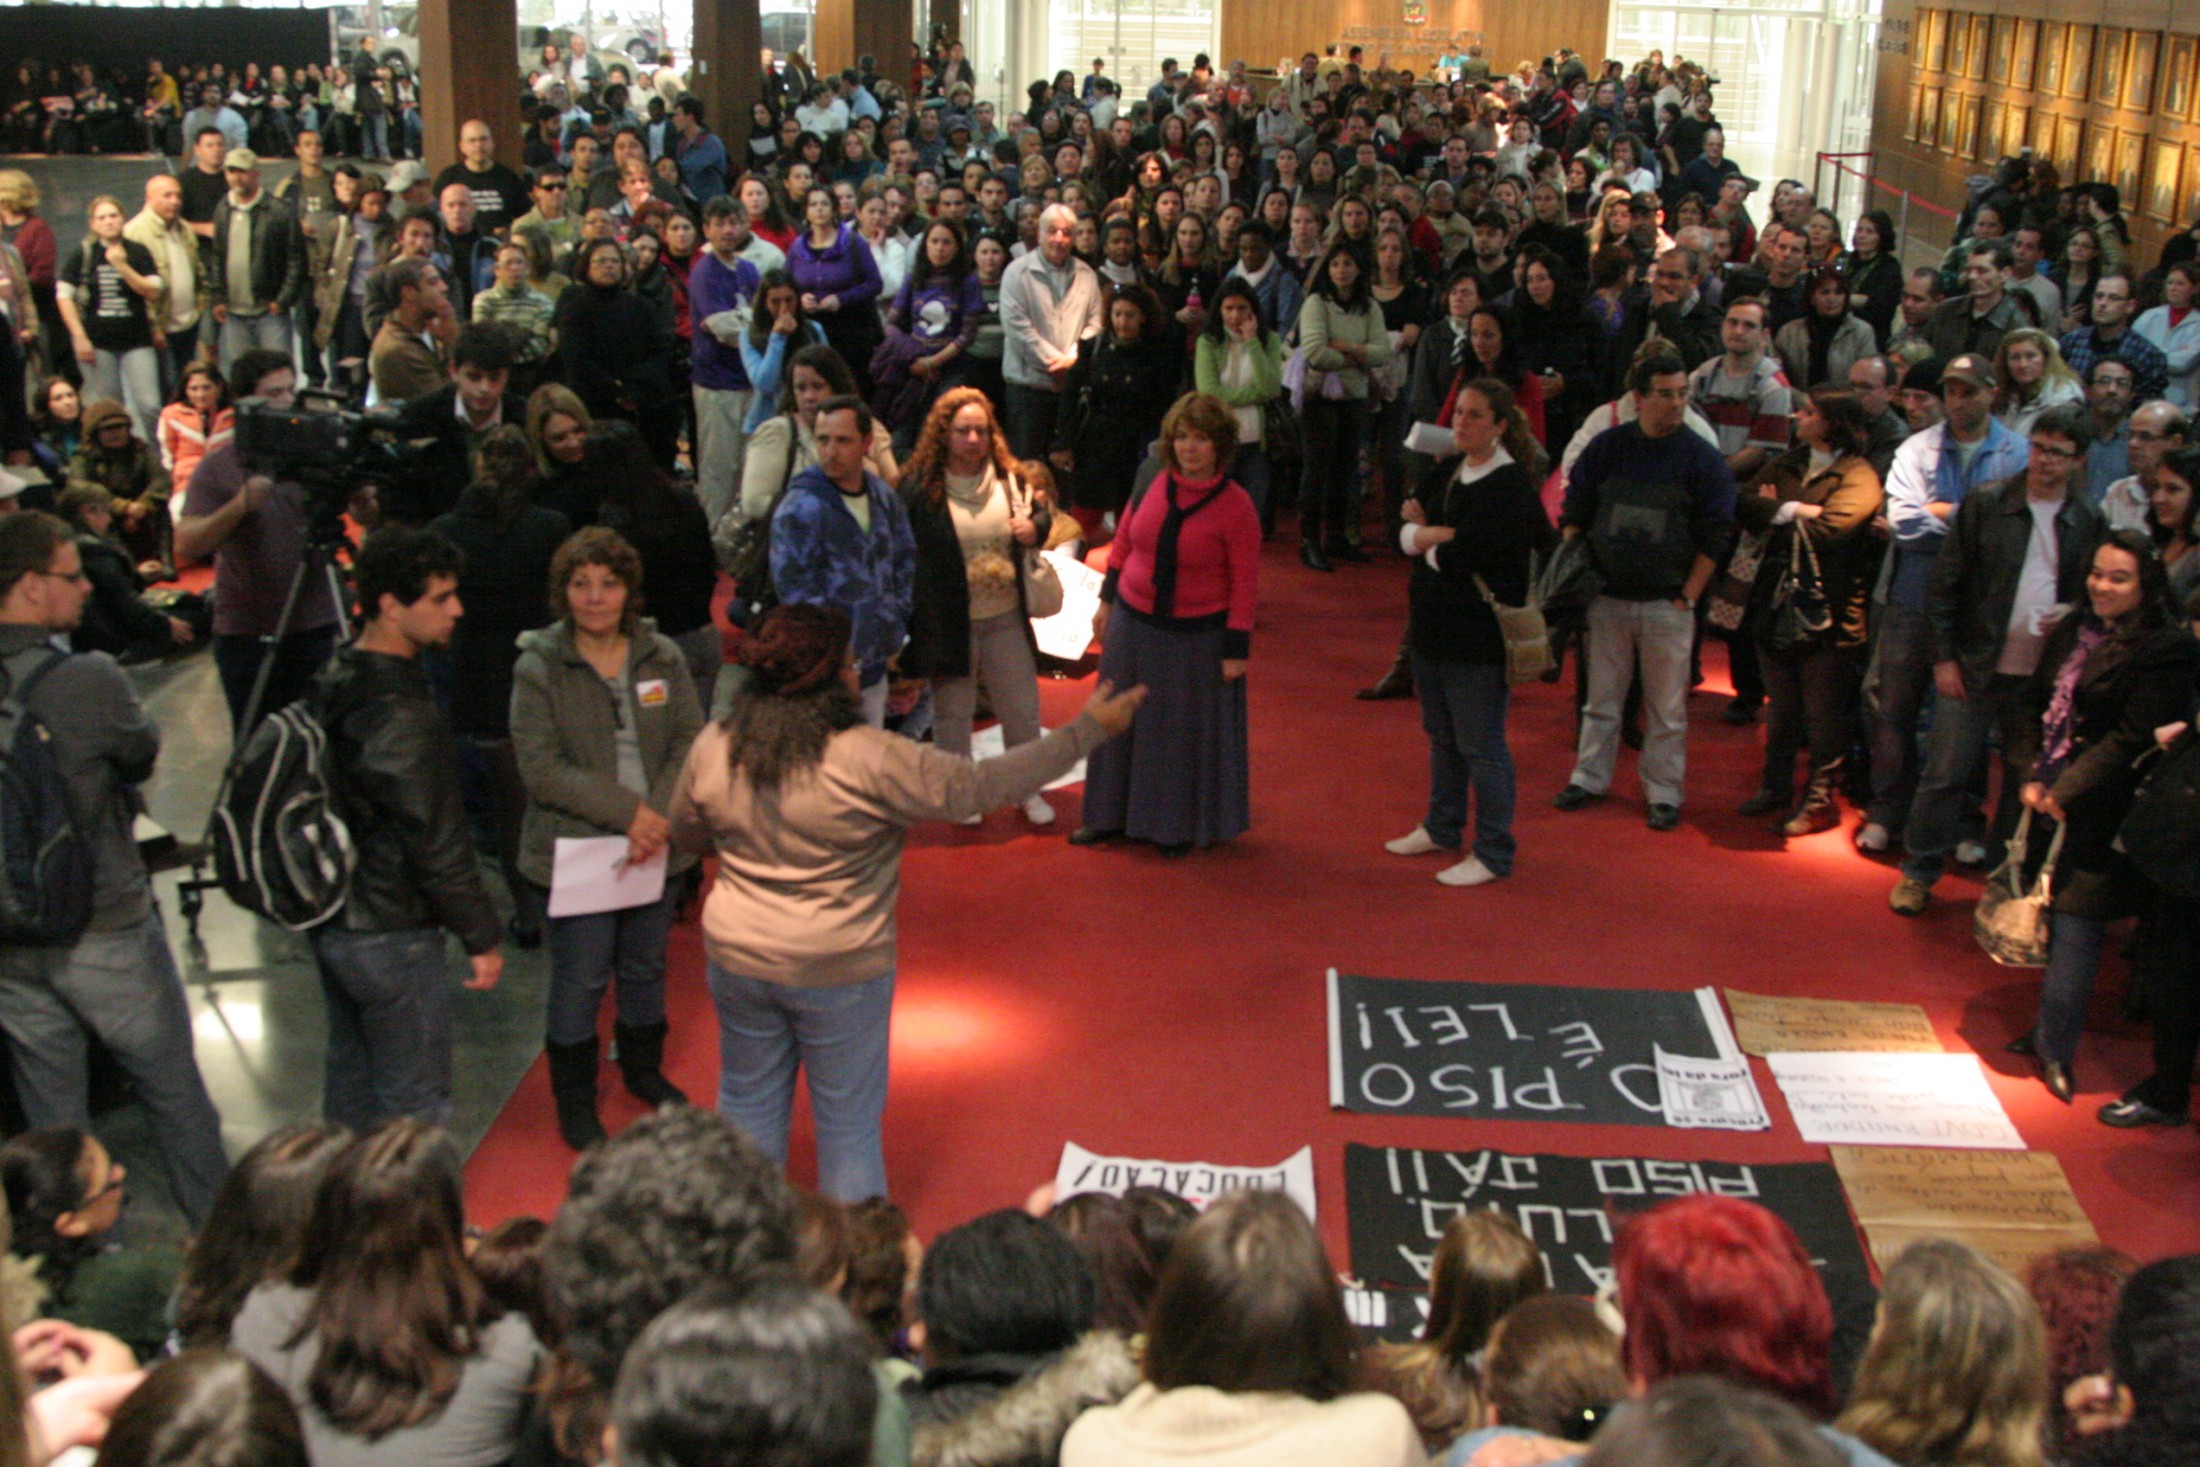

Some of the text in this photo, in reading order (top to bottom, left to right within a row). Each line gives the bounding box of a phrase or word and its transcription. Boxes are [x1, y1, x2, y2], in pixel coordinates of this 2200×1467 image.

[1357, 1001, 1604, 1069] É LEI!
[1360, 1062, 1585, 1111] PISO
[1591, 1158, 1759, 1197] PISO
